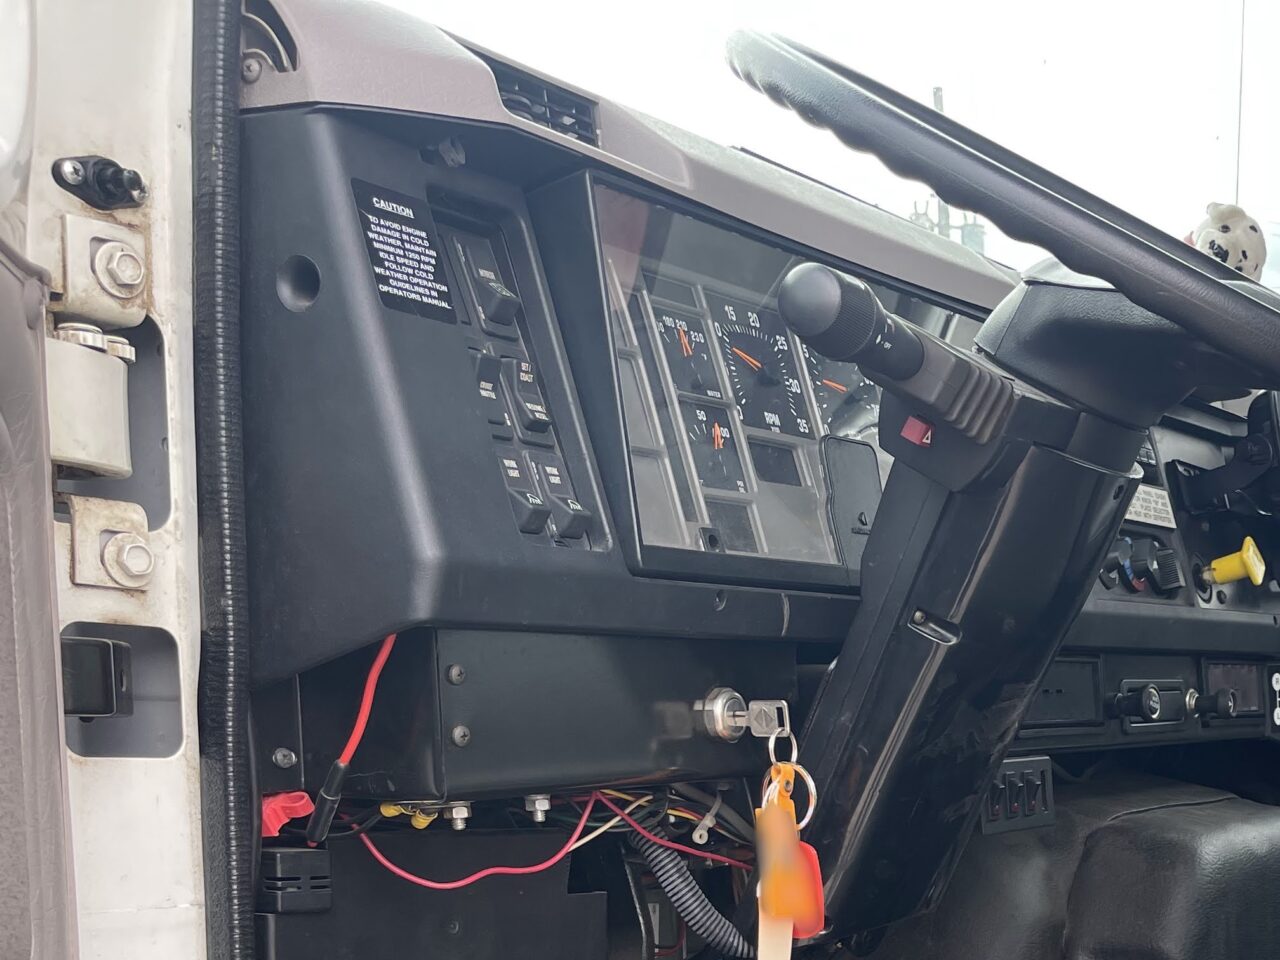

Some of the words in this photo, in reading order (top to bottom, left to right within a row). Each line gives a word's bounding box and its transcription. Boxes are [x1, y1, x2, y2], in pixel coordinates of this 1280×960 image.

[372, 197, 415, 218] CAUTION
[369, 215, 379, 223] TO
[380, 219, 401, 231] AVOID
[402, 225, 427, 238] ENGINE
[371, 224, 401, 238] DAMAGE
[410, 236, 429, 247] COLD
[373, 241, 403, 255] MINIMUM
[421, 254, 436, 265] RPM
[405, 243, 437, 257] MAINTAIN
[379, 251, 395, 262] IDLE
[396, 256, 419, 268] SPEED
[420, 263, 434, 272] AND
[374, 266, 408, 281] WEATHER
[409, 276, 448, 292] OPERATION
[385, 261, 414, 275] FOLLOW
[415, 269, 434, 280] COLD
[379, 284, 422, 301] OPERATORS
[389, 279, 430, 295] GUIDELINES
[724, 304, 736, 321] 15
[747, 311, 760, 328] 20
[775, 335, 788, 350] 25
[788, 378, 801, 394] 30
[696, 409, 706, 420] 50
[764, 411, 781, 426] RPM
[797, 418, 810, 433] 35
